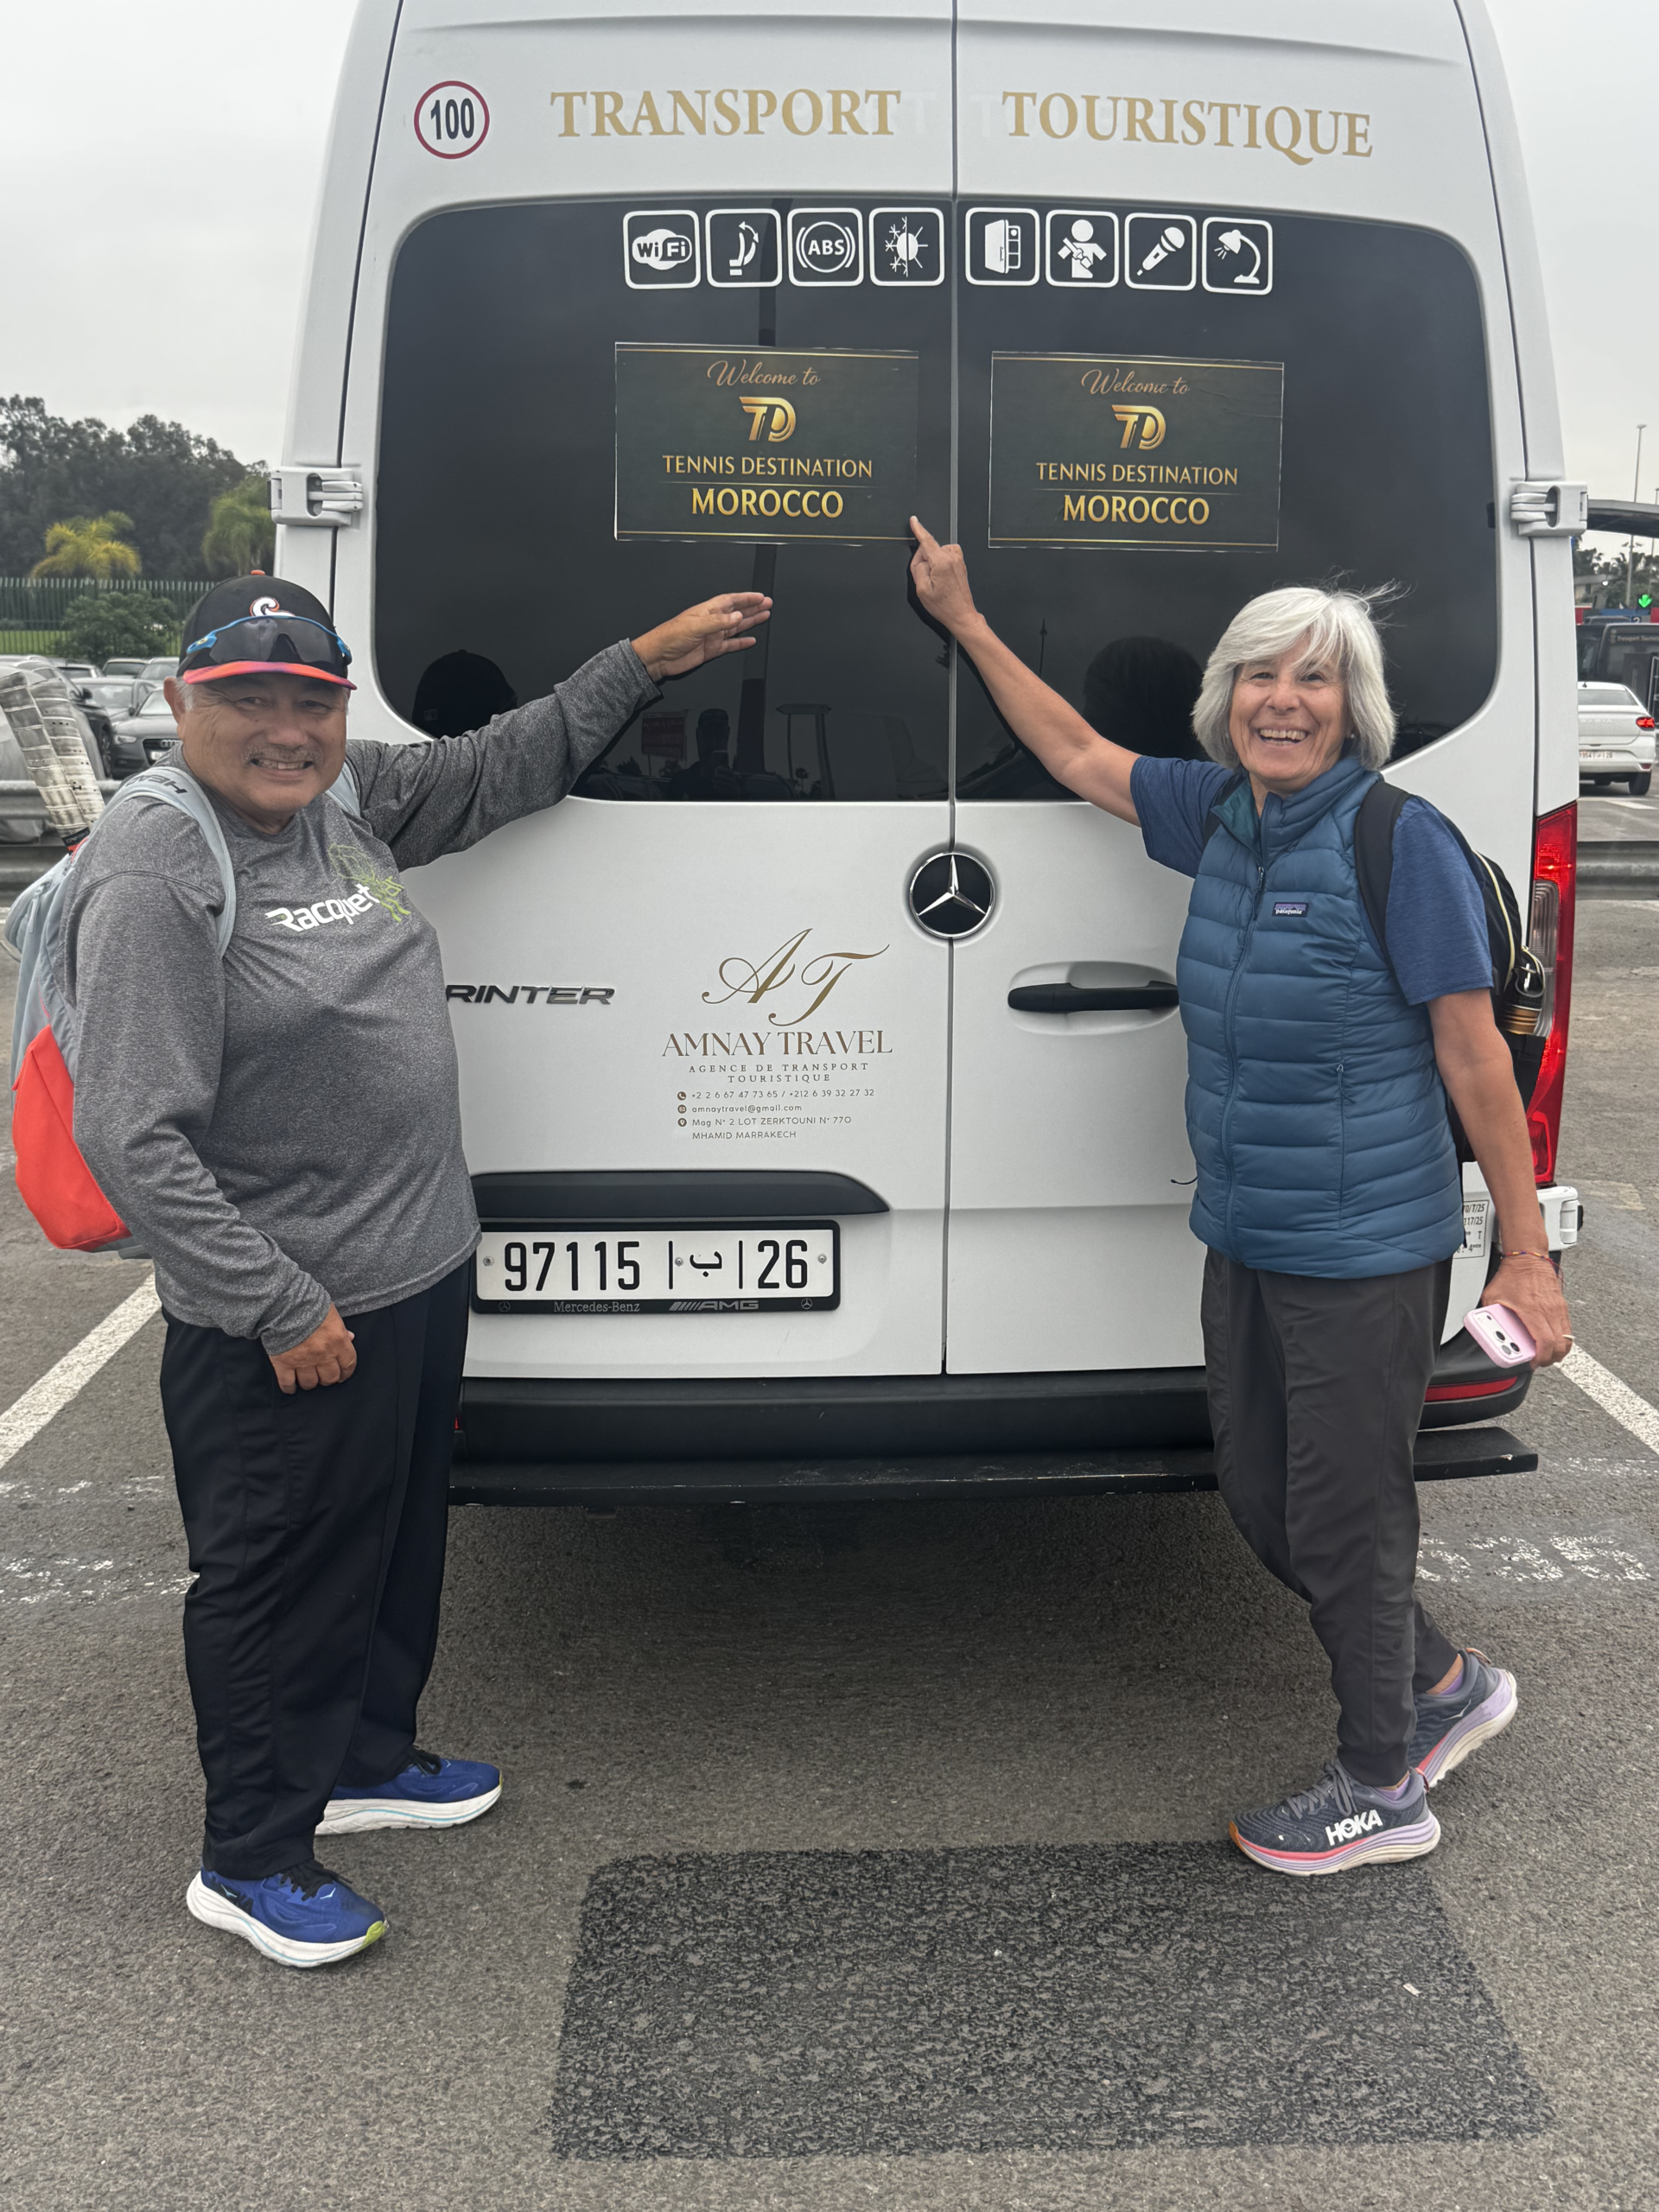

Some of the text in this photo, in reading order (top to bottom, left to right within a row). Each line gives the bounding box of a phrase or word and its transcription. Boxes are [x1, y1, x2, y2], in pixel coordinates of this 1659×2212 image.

[430, 98, 474, 140] 100
[550, 88, 1374, 165] TRANSPORT TOURISTIQUE
[808, 238, 845, 257] ABS
[707, 359, 821, 386] Welcome to
[1080, 368, 1191, 396] Welcome to
[662, 454, 873, 478] TENNIS DESTINATION
[1036, 462, 1238, 486] TENNIS DESTINATION
[691, 487, 843, 518] MOROCCO
[1063, 494, 1210, 525] MOROCCO
[264, 883, 380, 932] Racquet
[662, 1030, 893, 1057] AMNAY TRAVEL
[728, 1074, 830, 1084] TOURISTIQUE
[782, 1062, 868, 1071] TRANSPORT
[822, 1089, 832, 1097] 39
[692, 1104, 803, 1114] amnaytravel@gmail.com
[692, 1119, 711, 1128] Mag
[738, 1117, 757, 1126] LOT
[760, 1116, 816, 1125] ZERKTOUNI
[735, 1130, 797, 1139] MARRAKECH
[504, 1241, 641, 1292] 97115
[757, 1239, 808, 1289] 26
[553, 1300, 760, 1314] Mercedes-Benz AMG
[1325, 1809, 1382, 1846] HOKA
